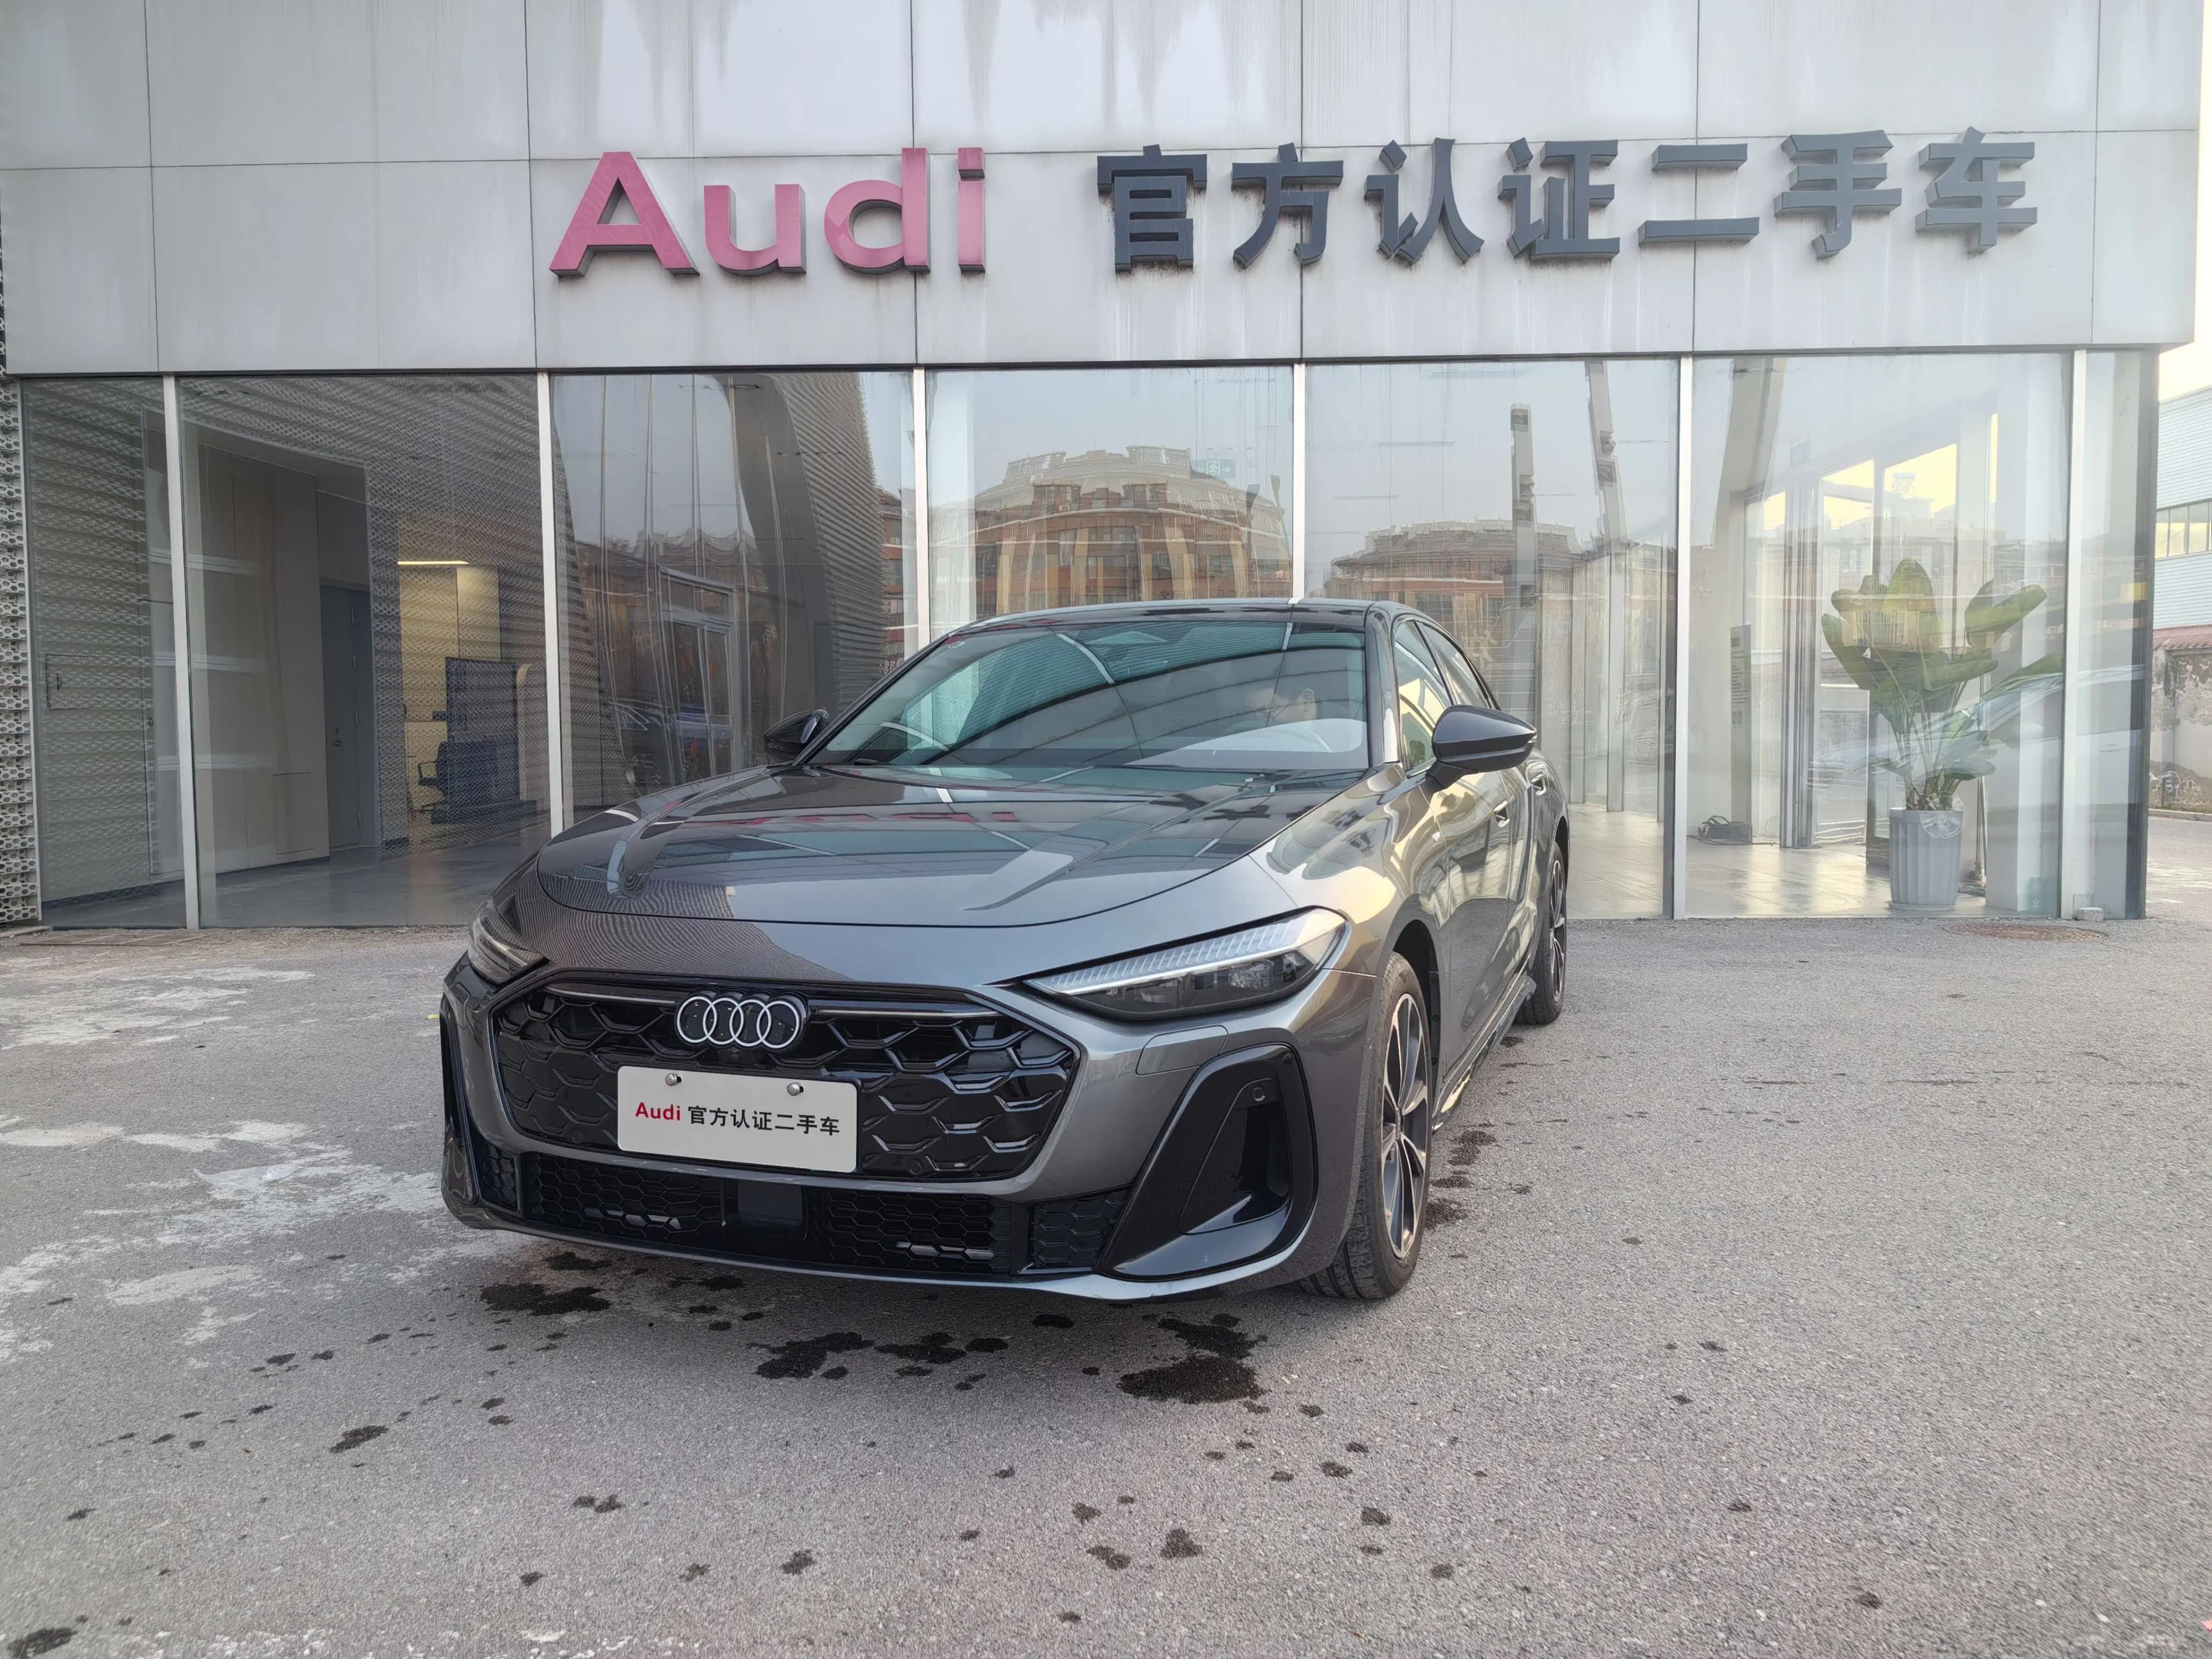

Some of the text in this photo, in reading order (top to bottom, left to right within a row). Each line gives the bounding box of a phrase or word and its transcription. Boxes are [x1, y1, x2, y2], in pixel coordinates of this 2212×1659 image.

[549, 127, 2037, 277] Audi 官方认证二手车
[635, 1102, 840, 1136] Audi 官方认证二手车
